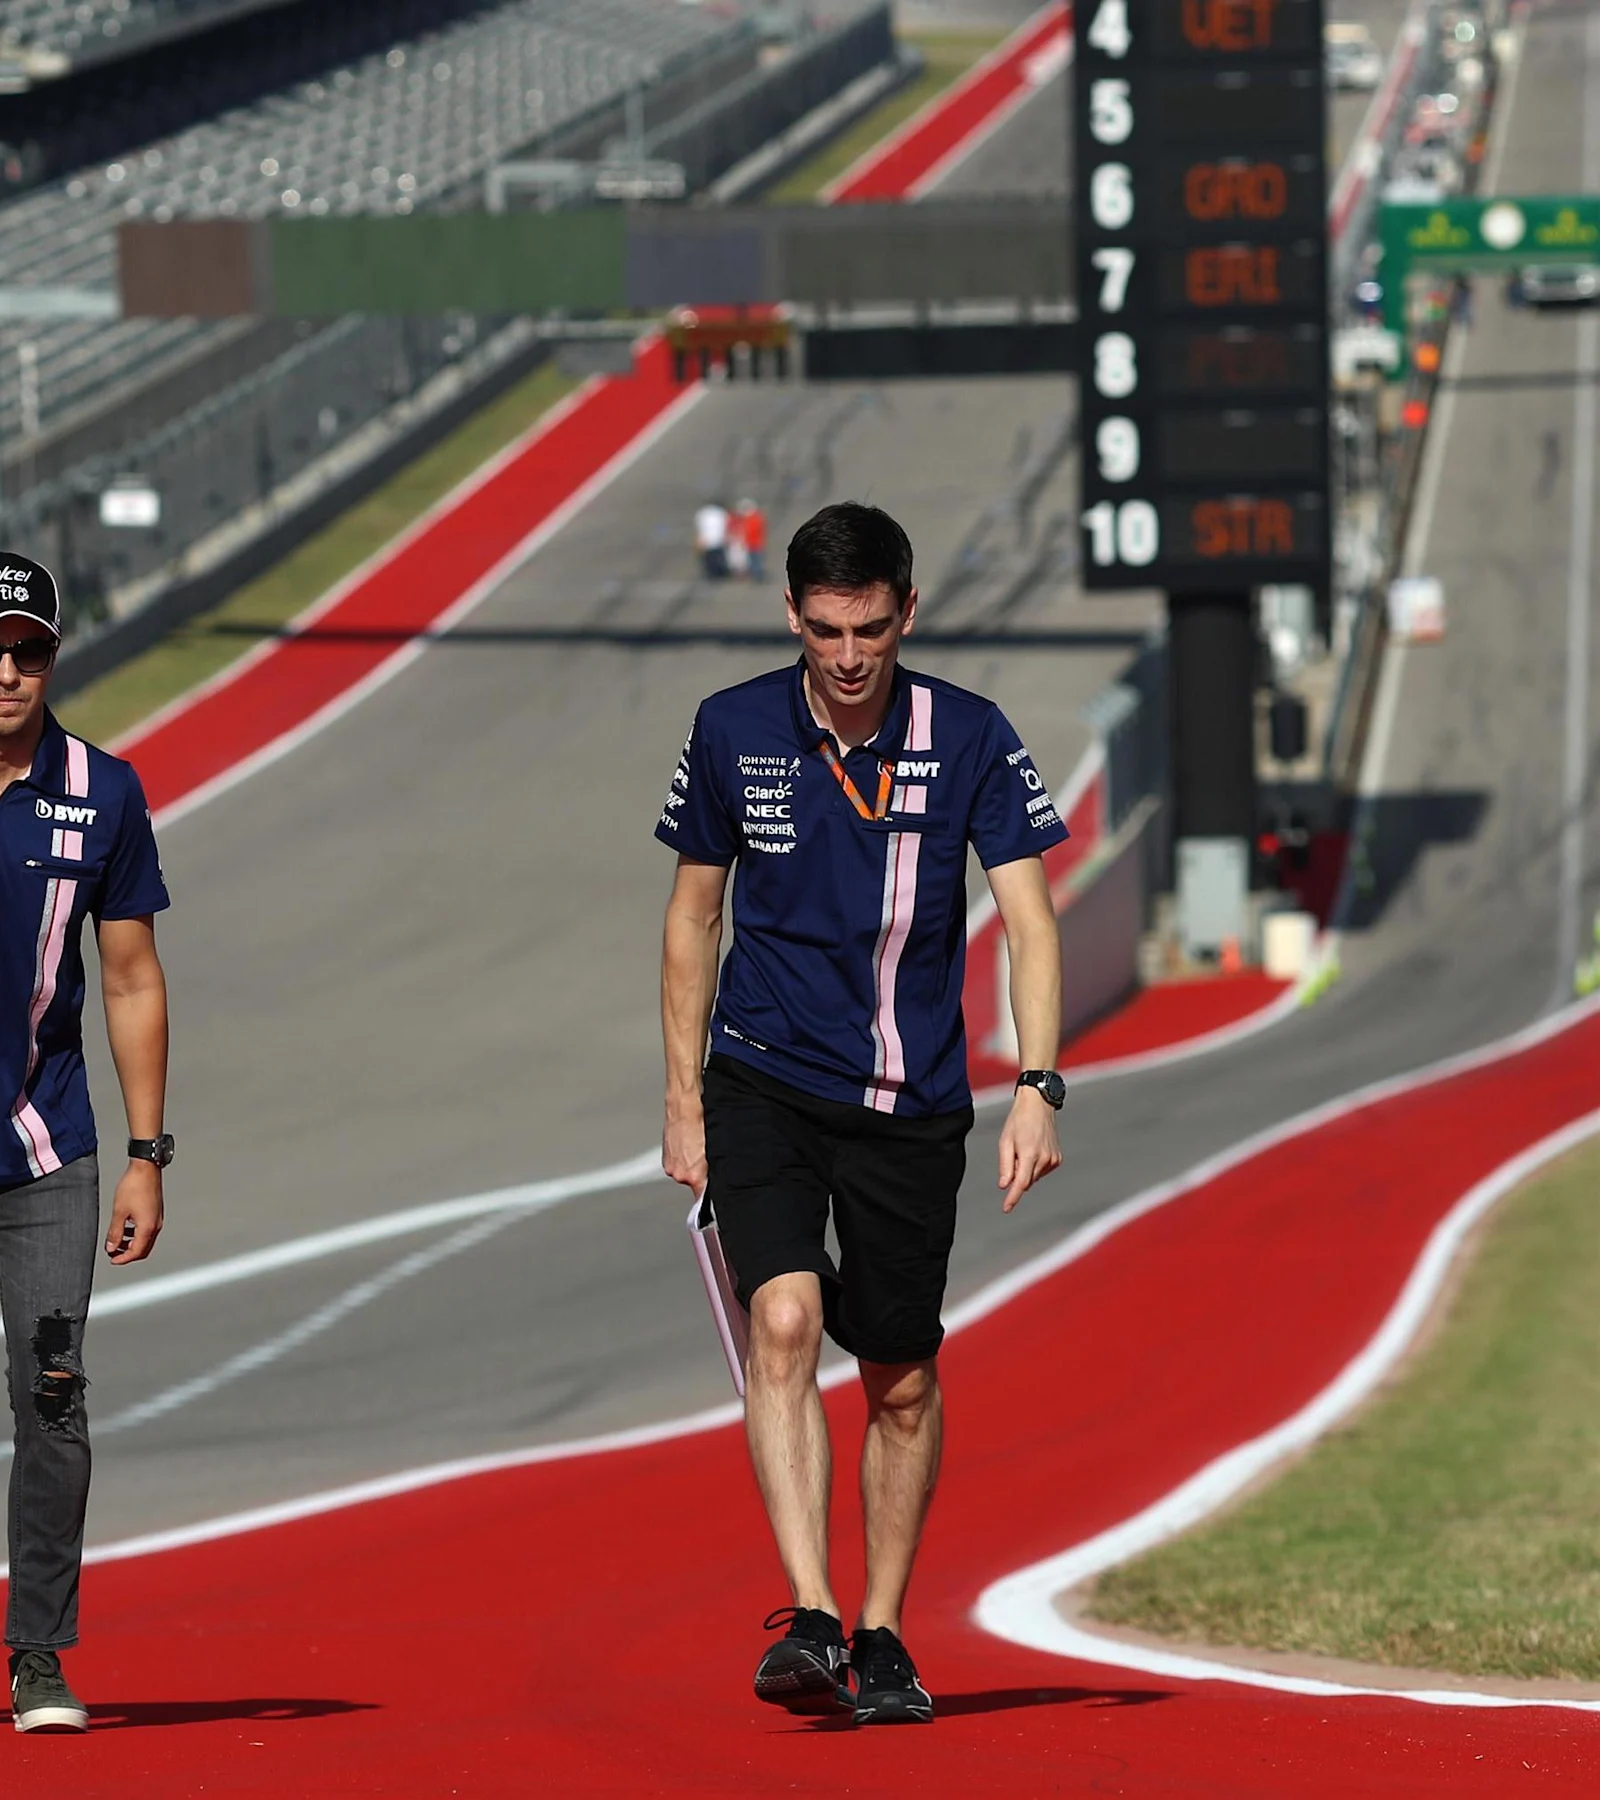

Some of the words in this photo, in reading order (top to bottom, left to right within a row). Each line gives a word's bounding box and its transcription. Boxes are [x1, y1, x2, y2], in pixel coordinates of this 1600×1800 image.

[1088, 0, 1133, 59] 4
[1090, 77, 1134, 145] 5
[1090, 161, 1134, 230] 6
[1184, 162, 1288, 222] GRO
[1092, 247, 1135, 314] 7
[1186, 245, 1281, 308] ERI
[1094, 331, 1138, 399] 8
[1096, 415, 1140, 483] 9
[1082, 499, 1159, 566] 10
[1193, 500, 1293, 558] STR
[737, 755, 787, 767] JOHNNIE
[741, 766, 787, 776] WALKER
[896, 761, 940, 777] BWT
[673, 768, 690, 789] PE
[744, 783, 789, 800] Claro
[53, 804, 98, 825] BWT
[746, 804, 791, 818] NEC
[1026, 793, 1054, 815] PIREL
[742, 821, 798, 838] KINGFISHER
